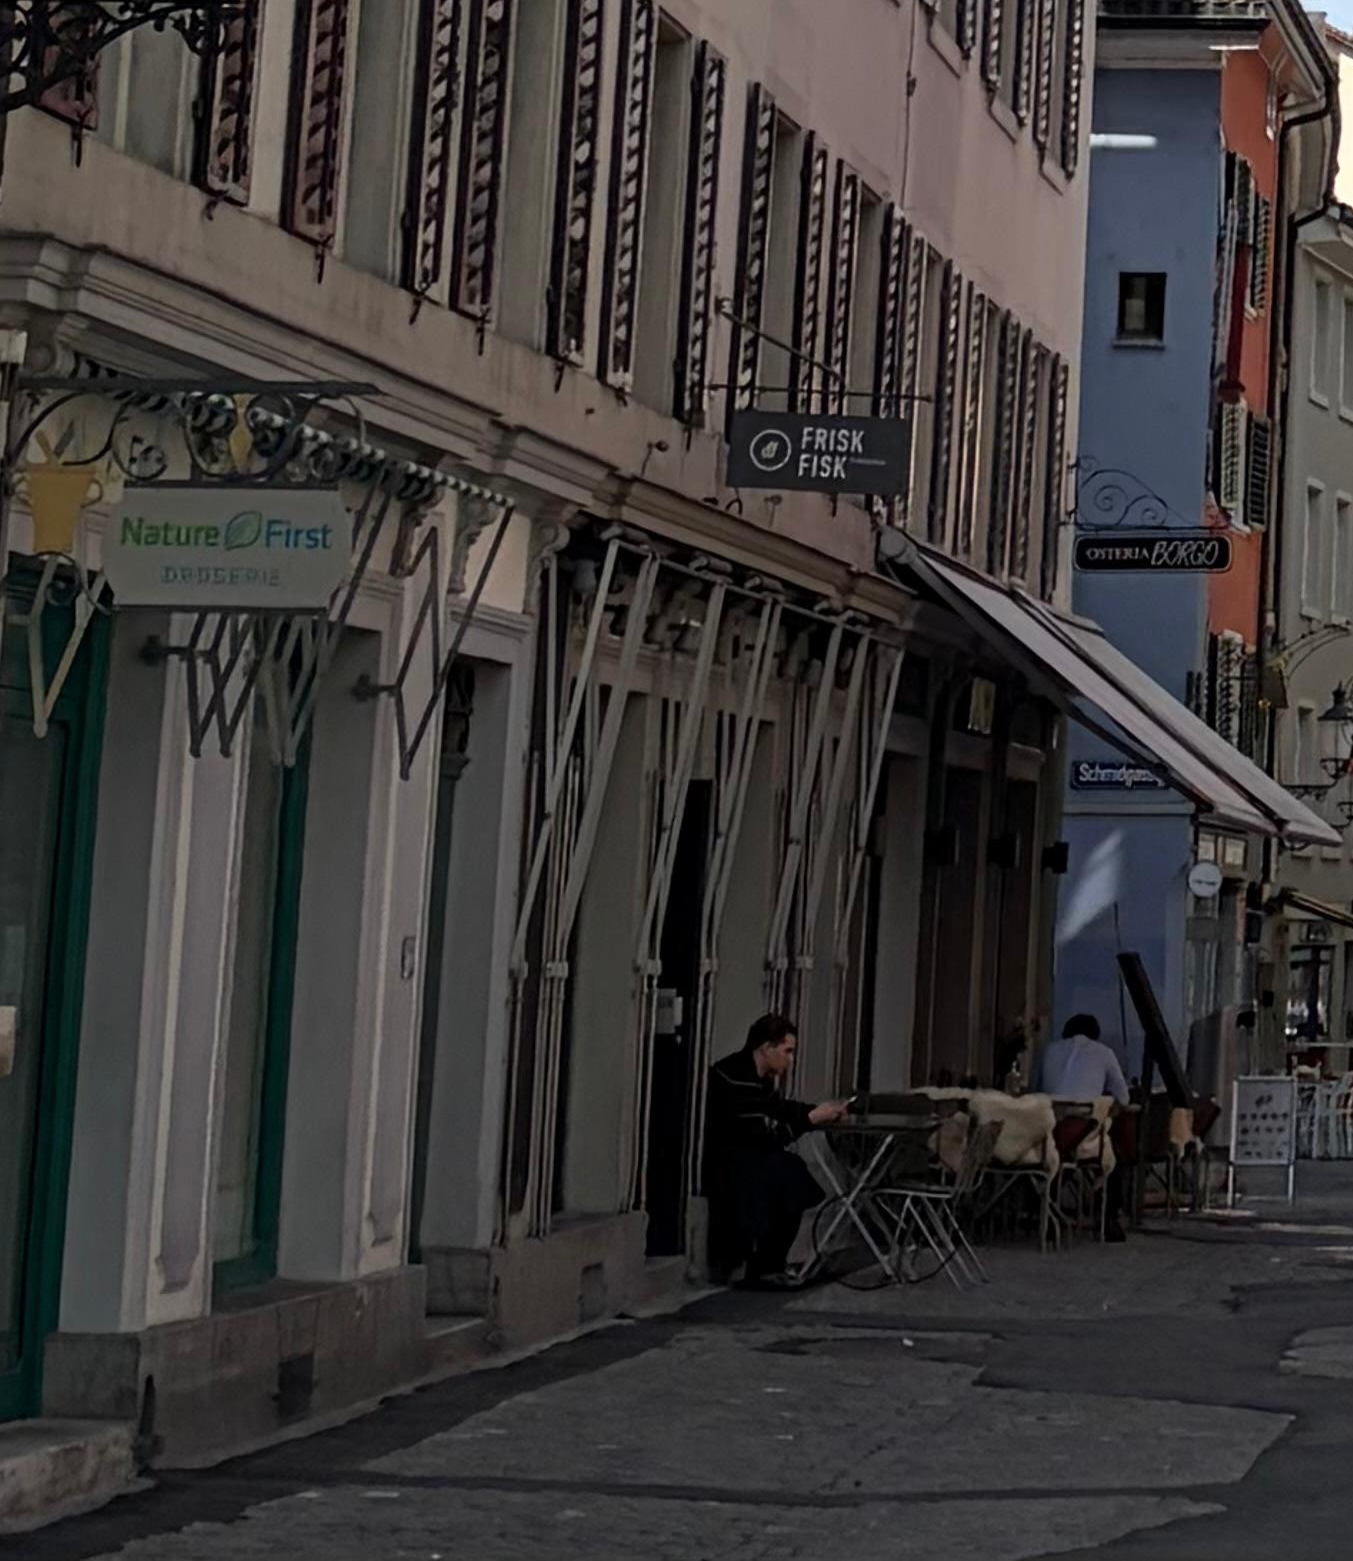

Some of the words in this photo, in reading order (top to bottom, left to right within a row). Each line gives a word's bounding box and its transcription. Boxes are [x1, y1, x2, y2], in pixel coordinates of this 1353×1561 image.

[801, 427, 864, 454] FRISK
[798, 453, 848, 479] FISK
[121, 516, 219, 547] Nature
[265, 519, 333, 549] First
[1086, 547, 1150, 561] OSTERIA
[1149, 541, 1219, 566] BORGO
[160, 566, 280, 586] DROGERIE
